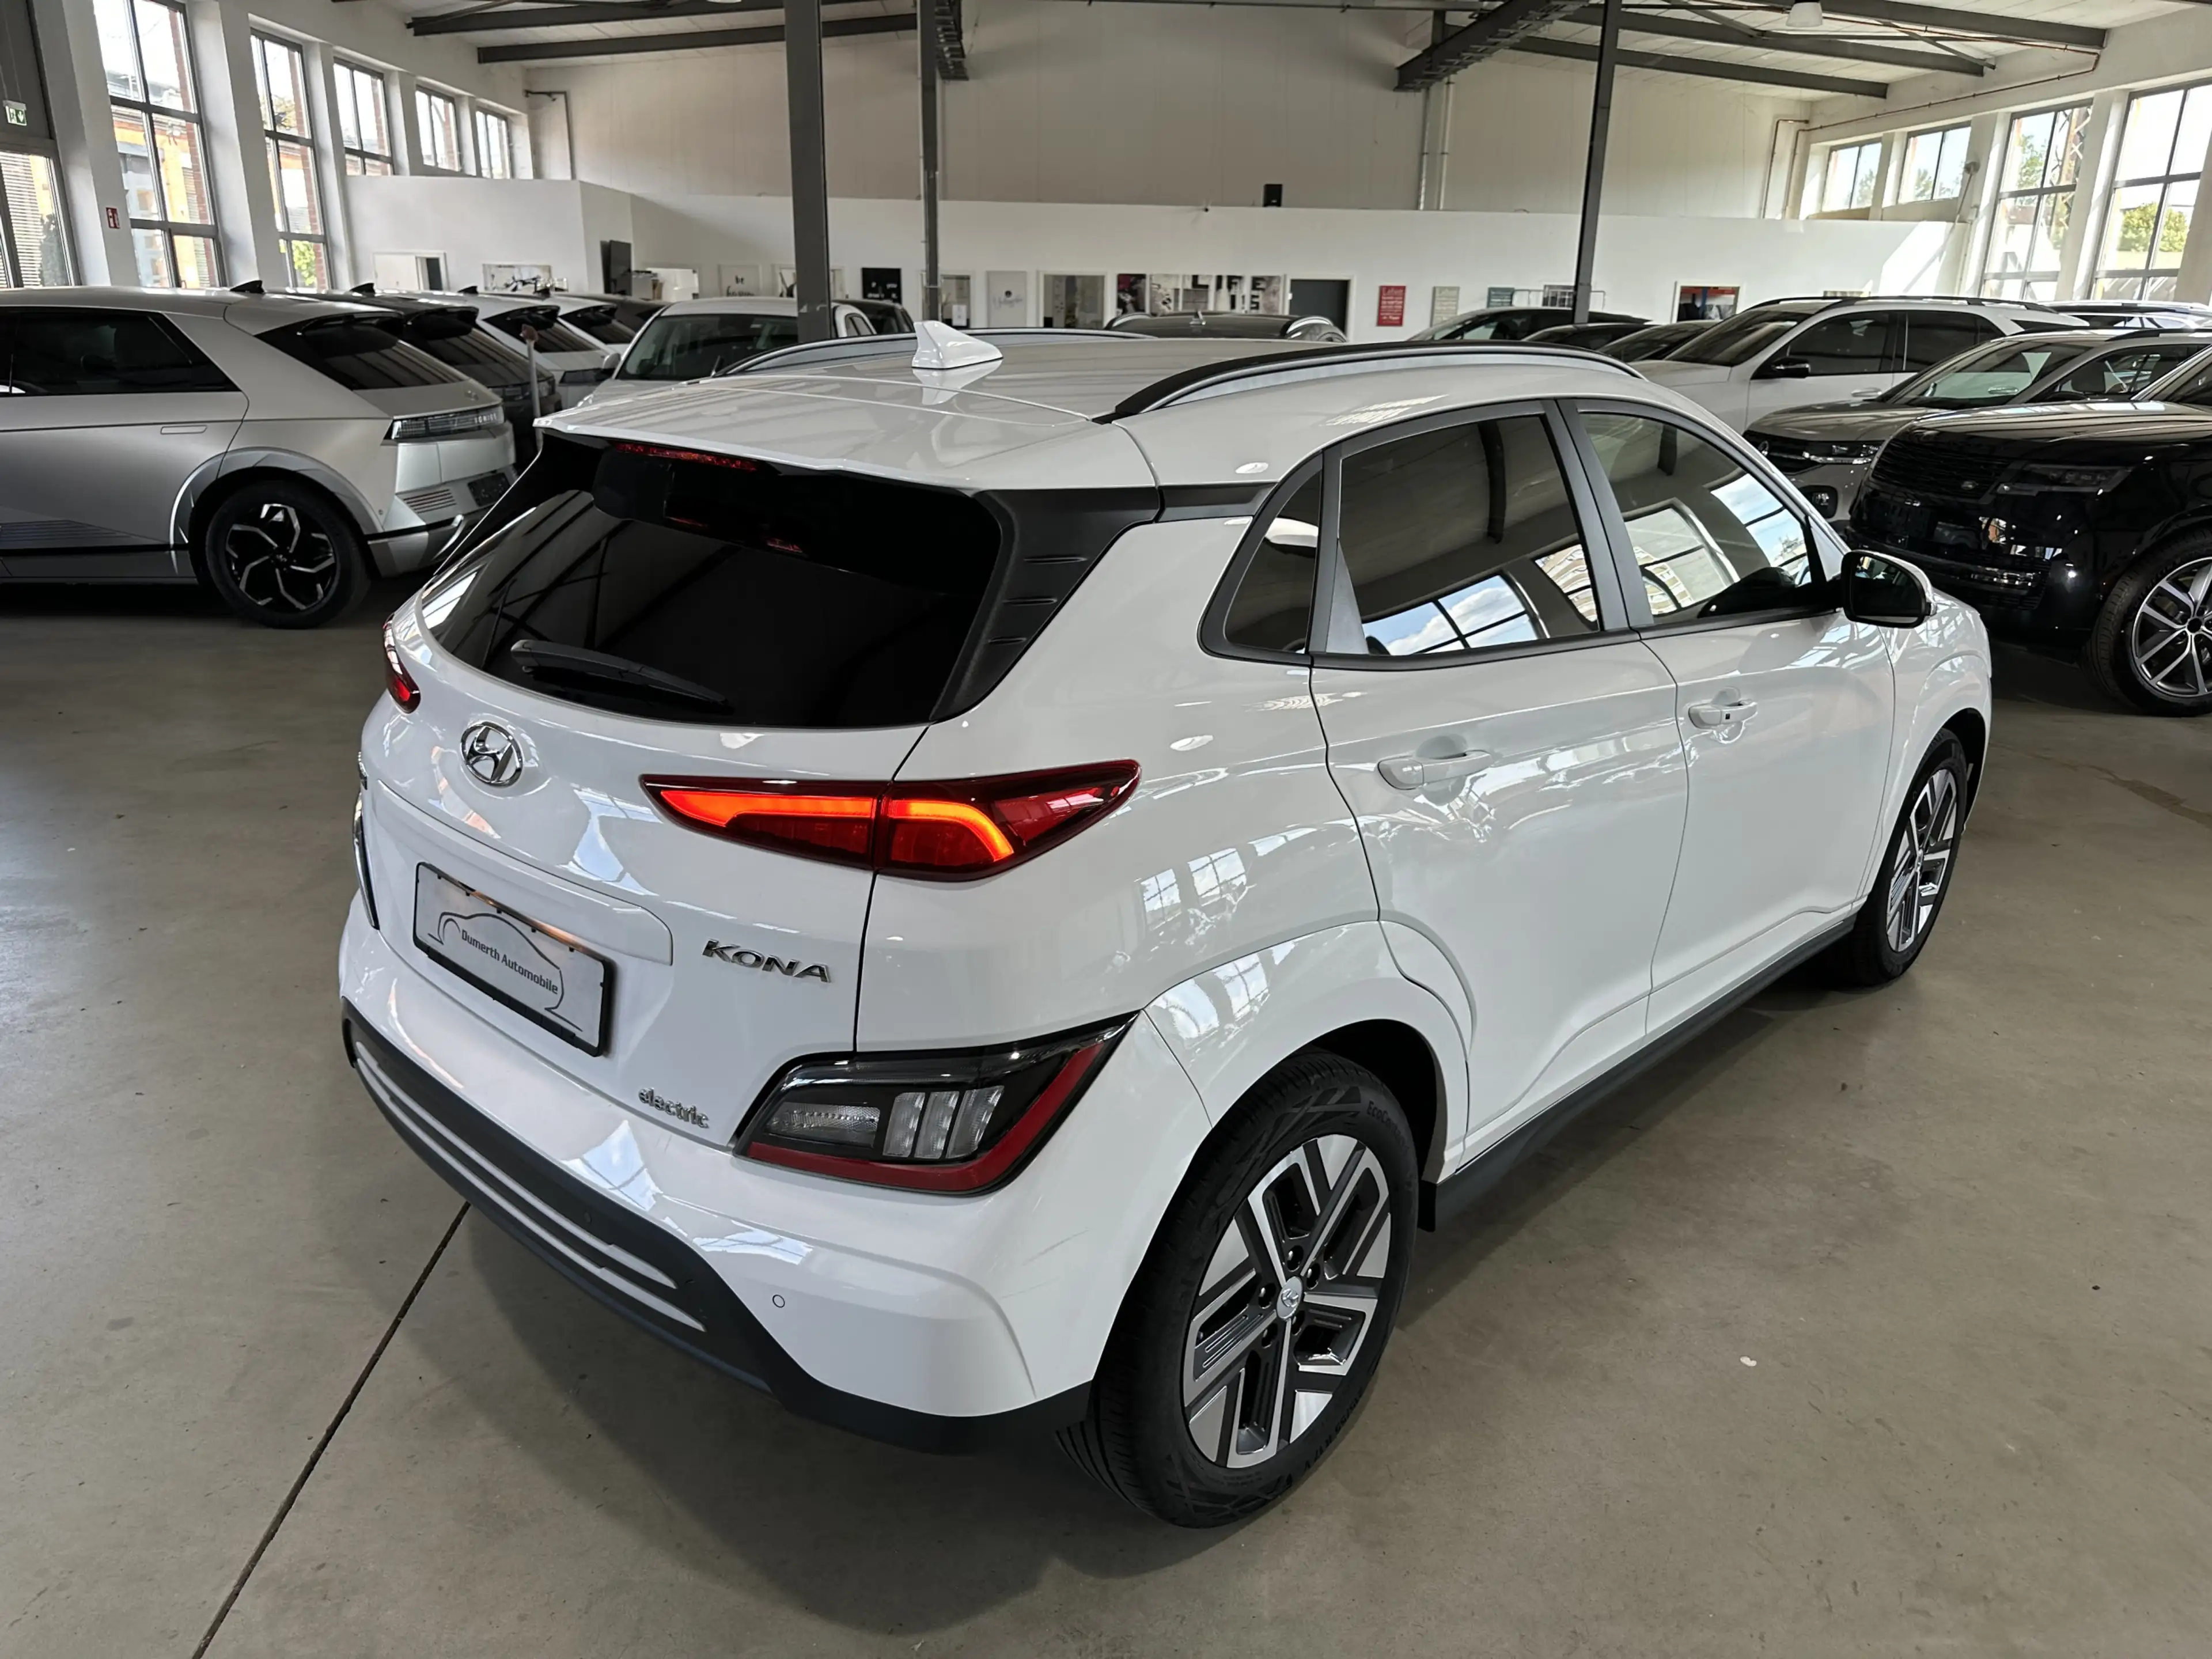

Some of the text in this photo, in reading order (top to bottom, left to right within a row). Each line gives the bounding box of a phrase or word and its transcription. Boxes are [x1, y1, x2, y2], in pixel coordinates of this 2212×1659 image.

[461, 929, 558, 995] Dumerth Automobile
[702, 938, 831, 983] KONA
[638, 1087, 710, 1129] electric
